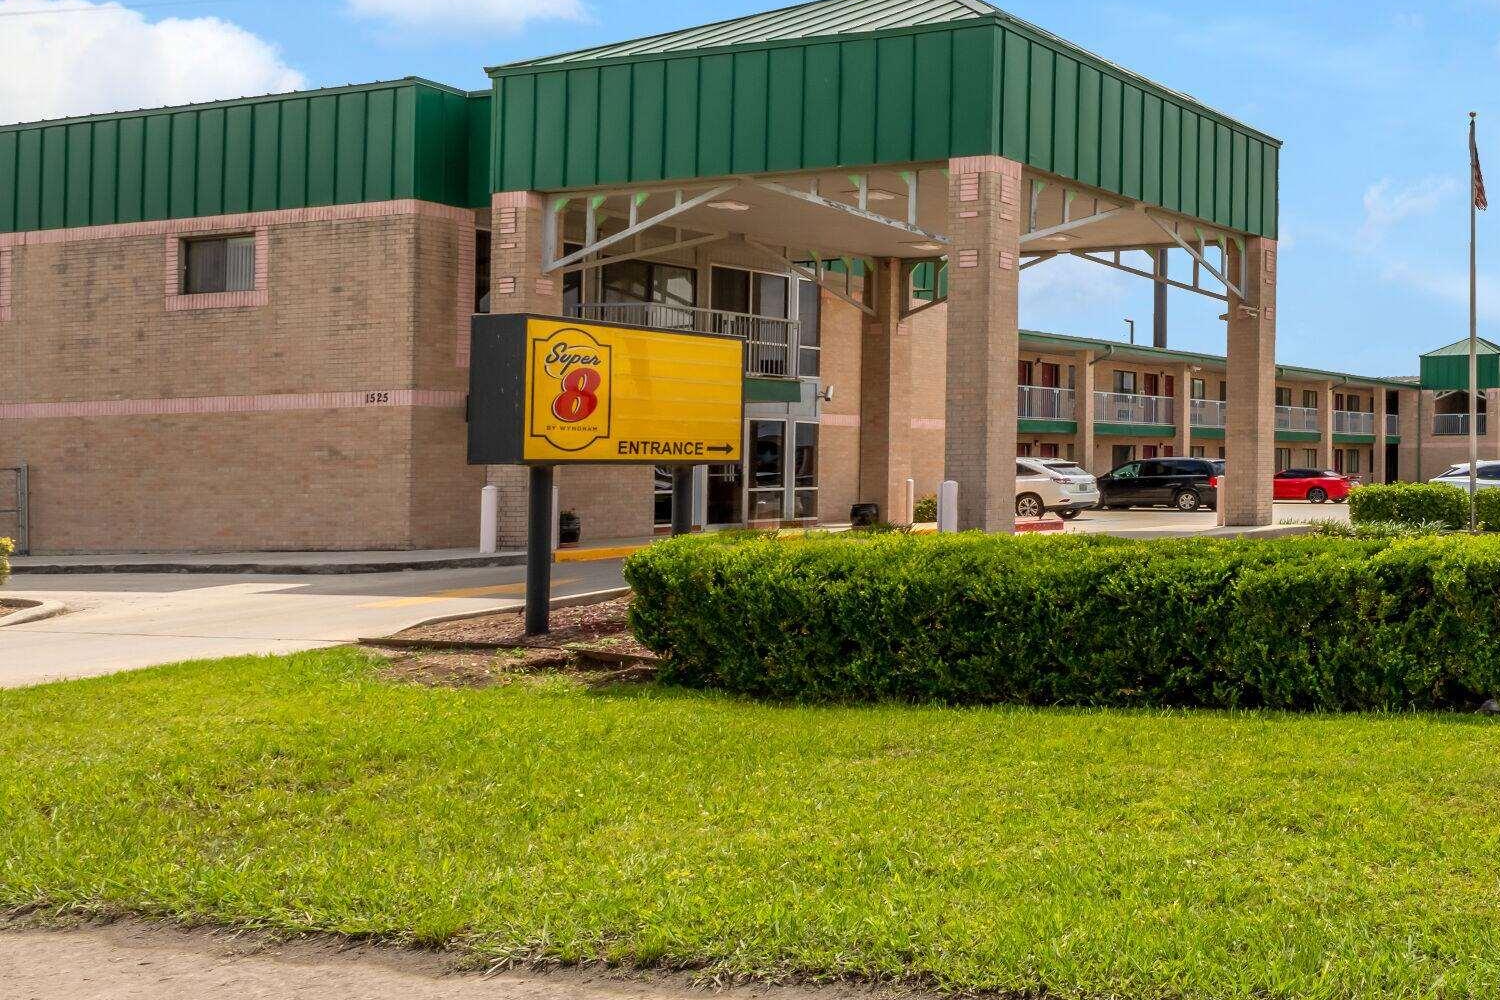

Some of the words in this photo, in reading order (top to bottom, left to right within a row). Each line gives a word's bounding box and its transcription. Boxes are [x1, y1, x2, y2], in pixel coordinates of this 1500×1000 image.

[546, 342, 601, 375] Super
[366, 392, 389, 403] 1525
[551, 367, 601, 423] 8
[618, 440, 704, 455] ENTRANCE
